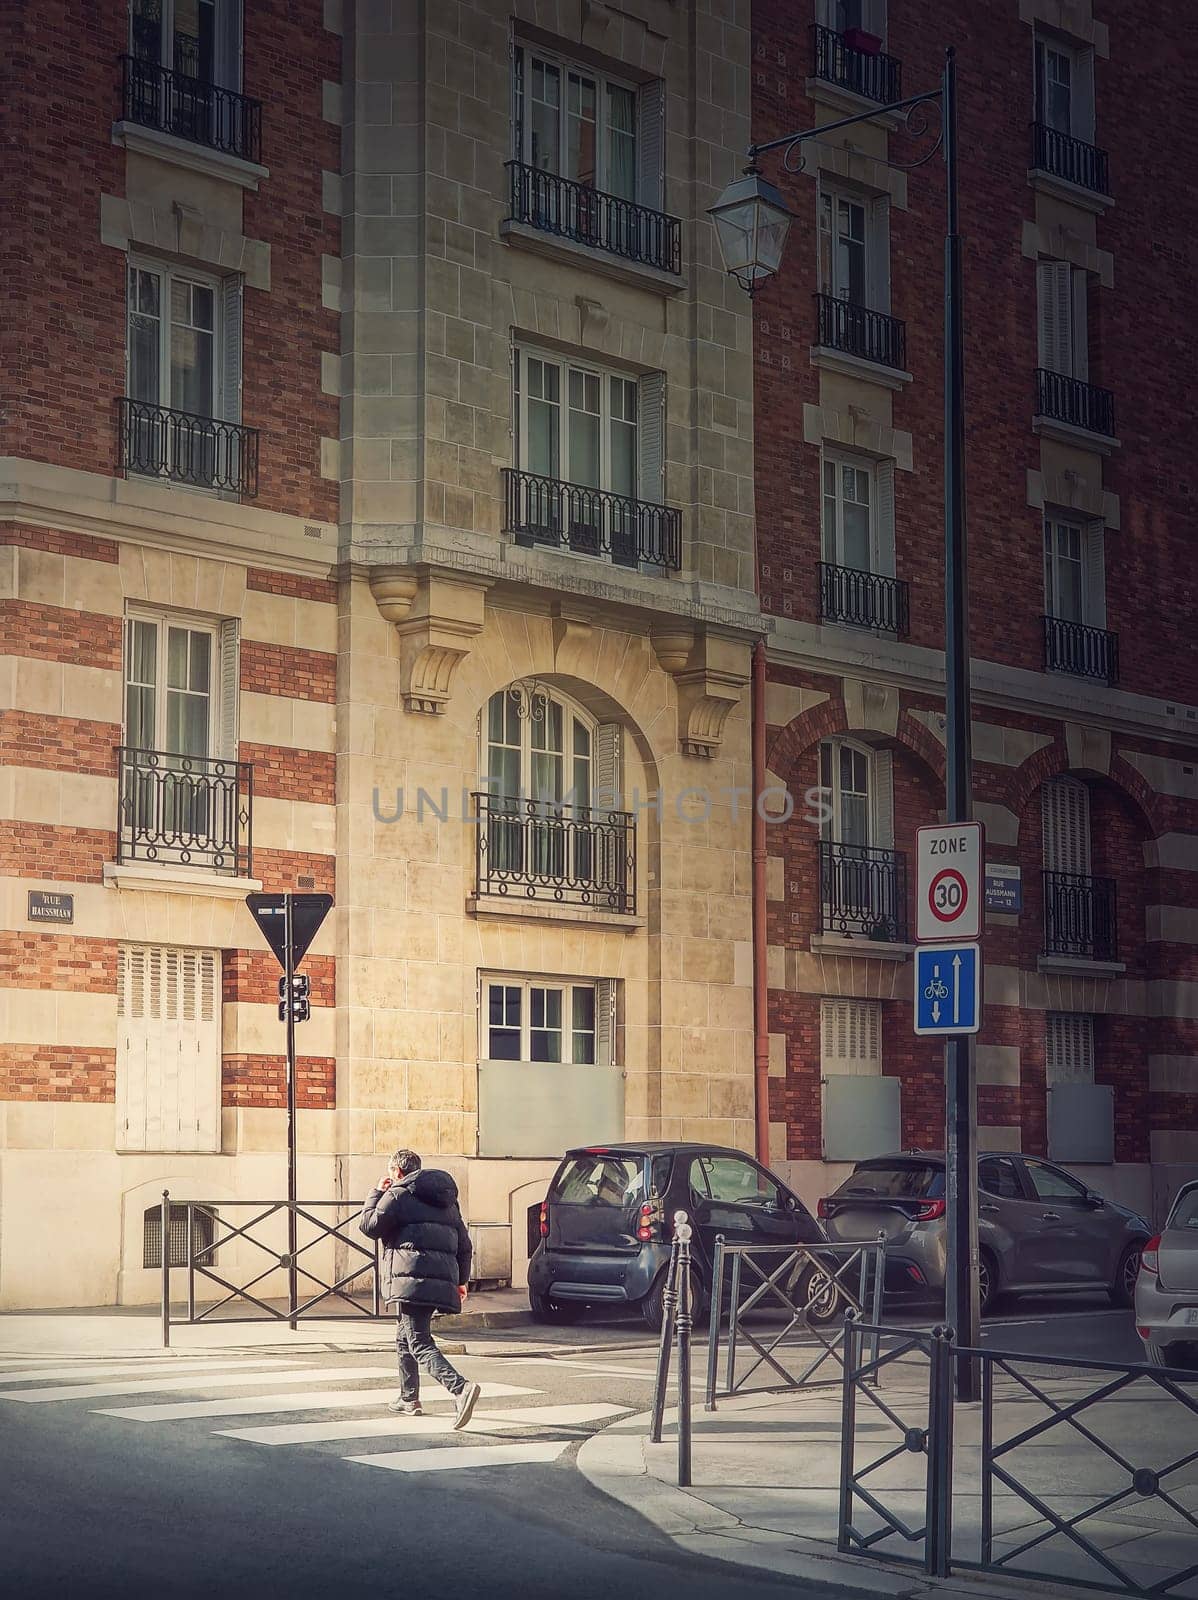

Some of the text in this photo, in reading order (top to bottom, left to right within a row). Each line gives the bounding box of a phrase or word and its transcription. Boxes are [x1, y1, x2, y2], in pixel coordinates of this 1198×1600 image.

[930, 837, 967, 855] ZONE
[936, 883, 961, 908] 30
[985, 888, 1016, 897] AUSSMANN
[43, 895, 61, 905] RUE
[32, 906, 71, 918] HAUSSMANN
